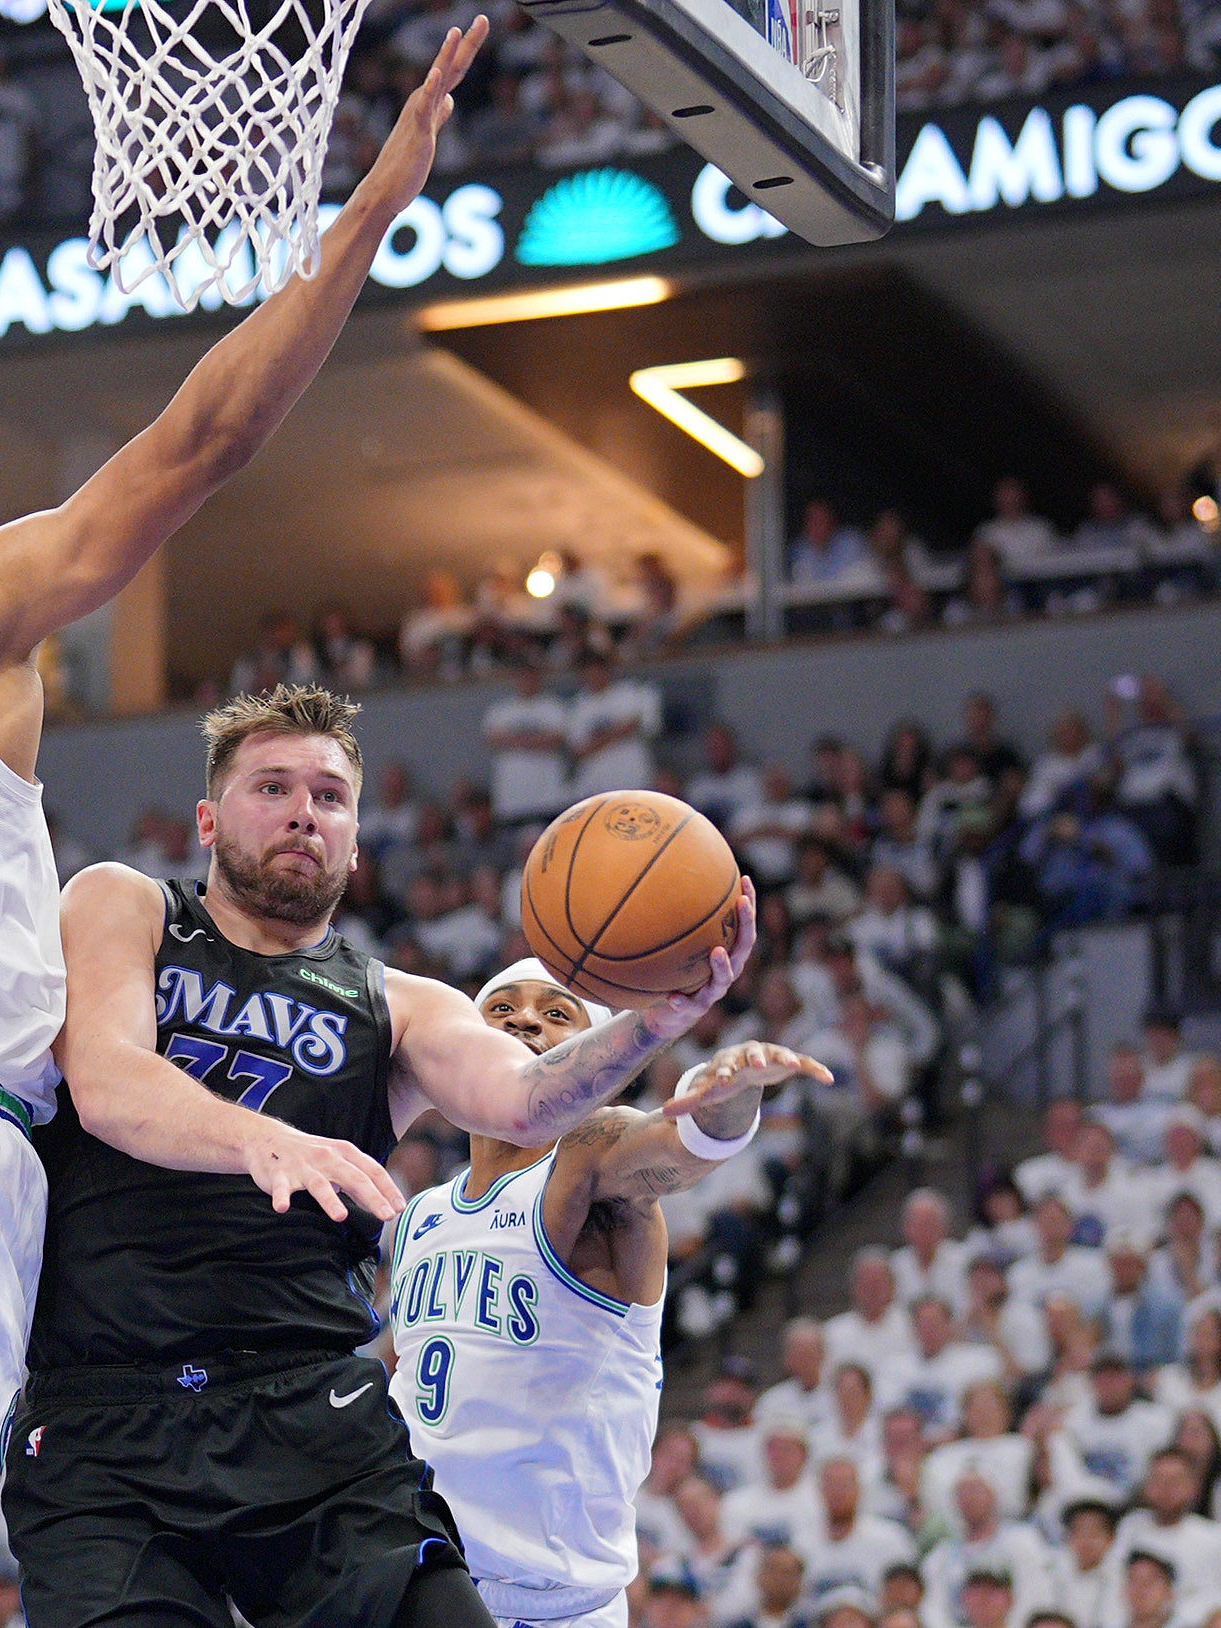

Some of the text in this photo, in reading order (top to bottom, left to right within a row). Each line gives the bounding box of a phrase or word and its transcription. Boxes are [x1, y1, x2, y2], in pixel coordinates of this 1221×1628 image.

[691, 82, 1221, 245] CAMIG
[157, 964, 347, 1076] MAVS
[300, 968, 359, 998] chime
[163, 1033, 294, 1113] 77
[415, 1334, 456, 1427] 9
